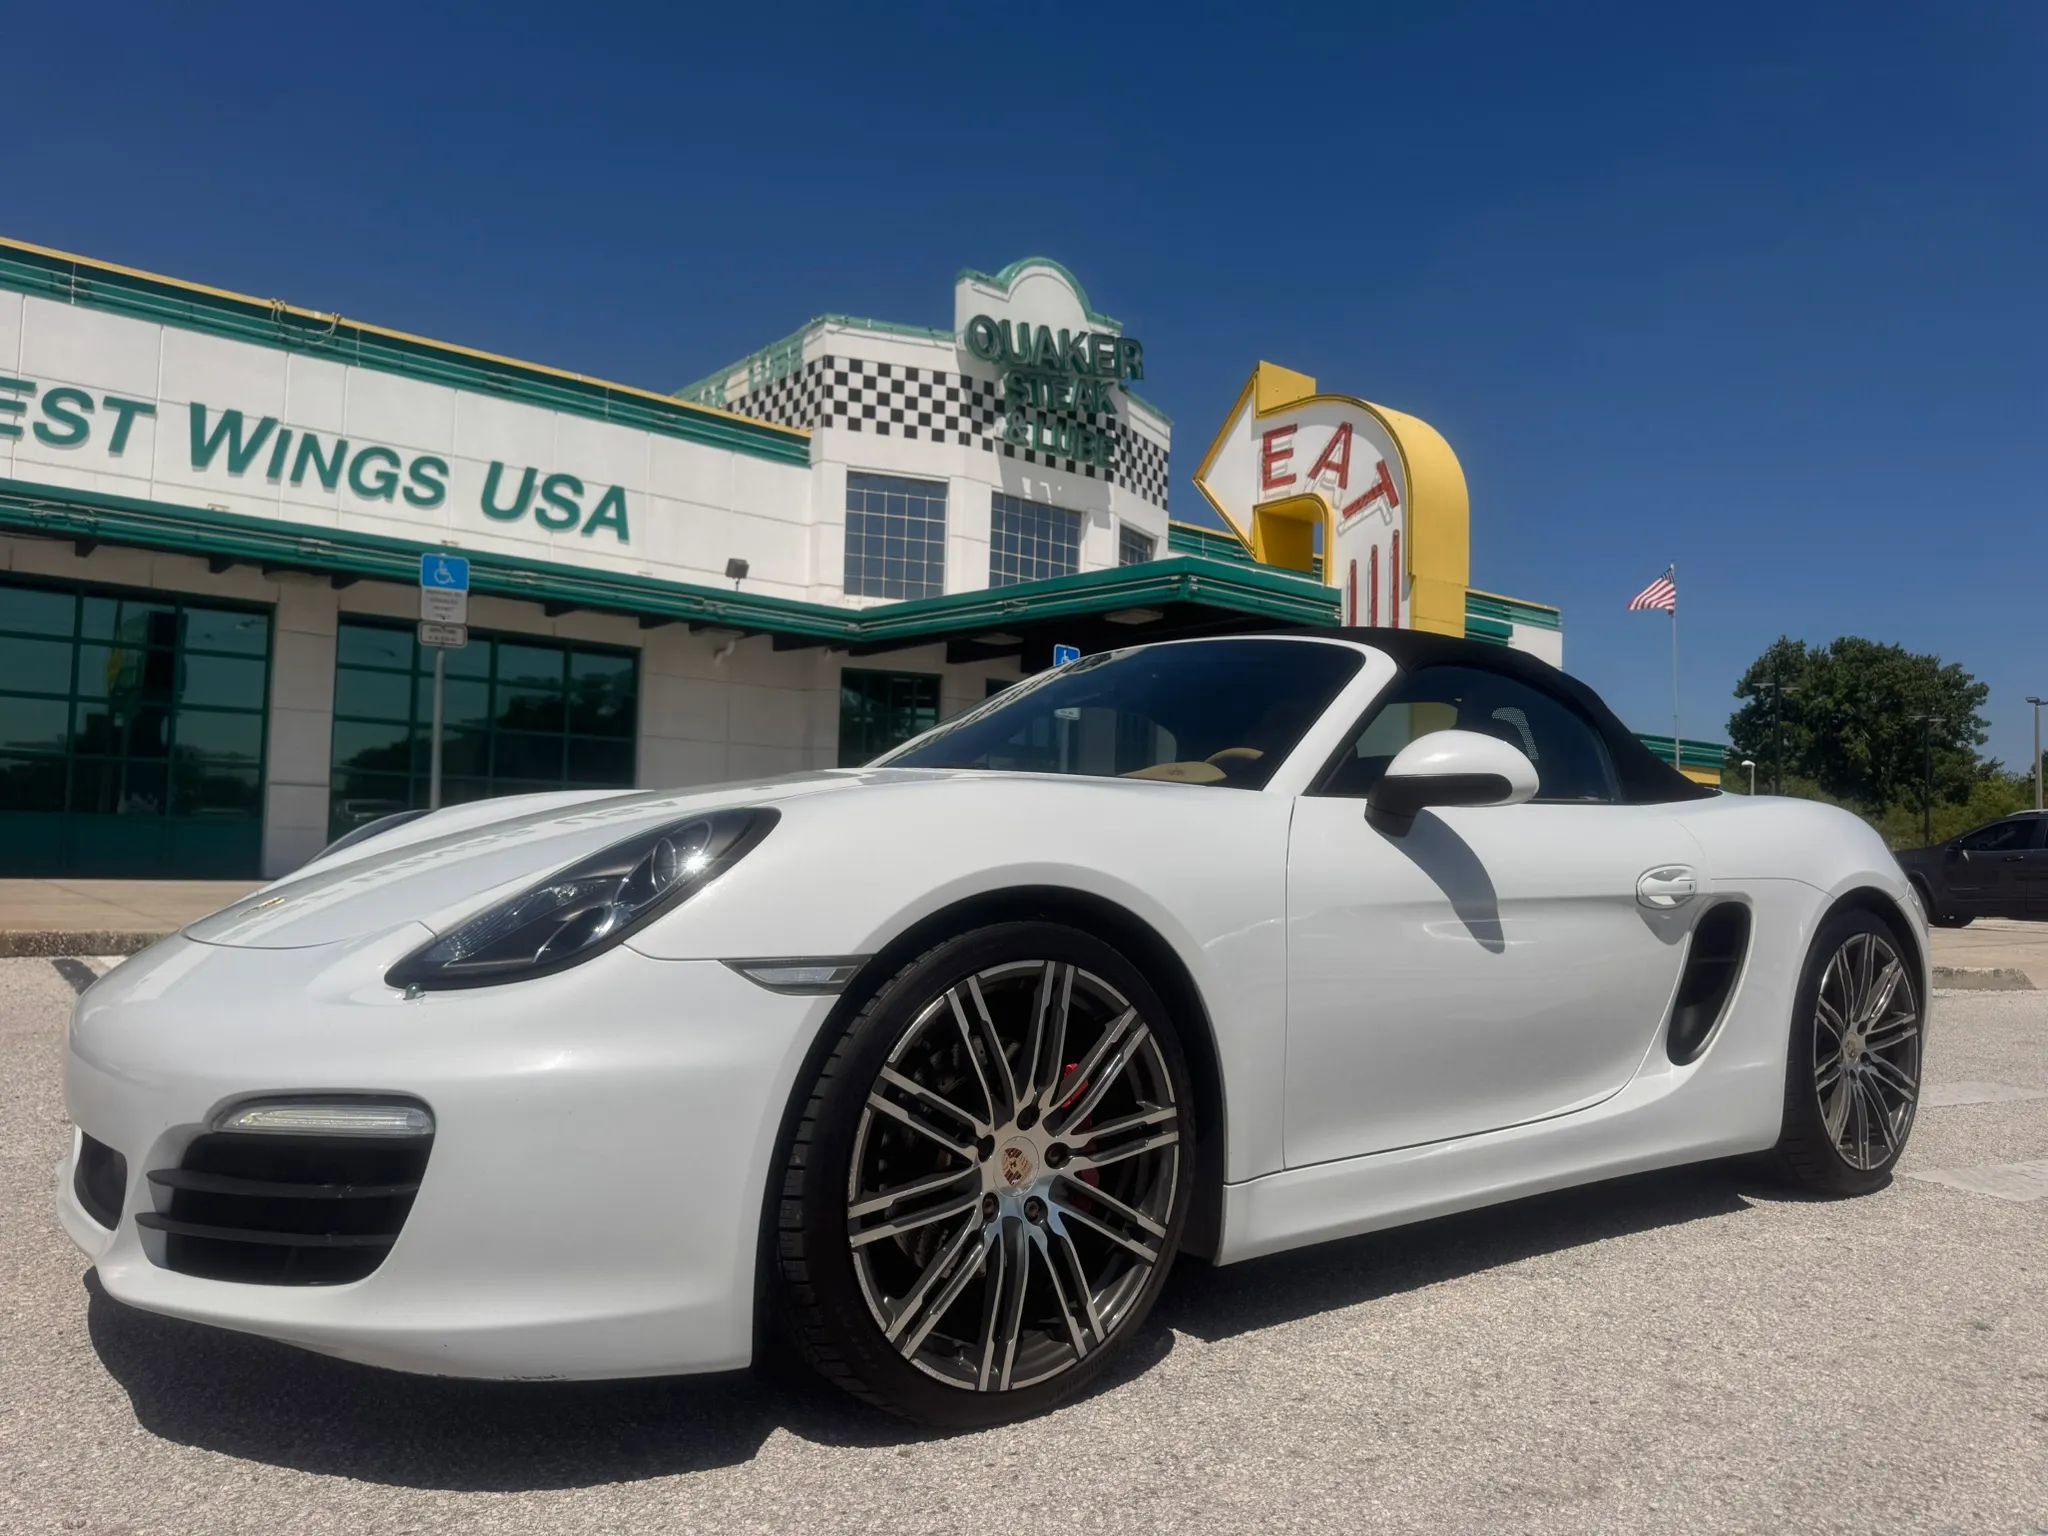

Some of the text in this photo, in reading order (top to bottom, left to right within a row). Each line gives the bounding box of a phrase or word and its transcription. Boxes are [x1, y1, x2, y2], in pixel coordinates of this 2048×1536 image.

[964, 314, 1144, 380] QUAKER
[1004, 370, 1118, 415] STEAK
[1004, 409, 1115, 468] & LUBE
[1262, 422, 1399, 519] EAT
[189, 402, 450, 509] WINGS
[481, 461, 630, 543] USA
